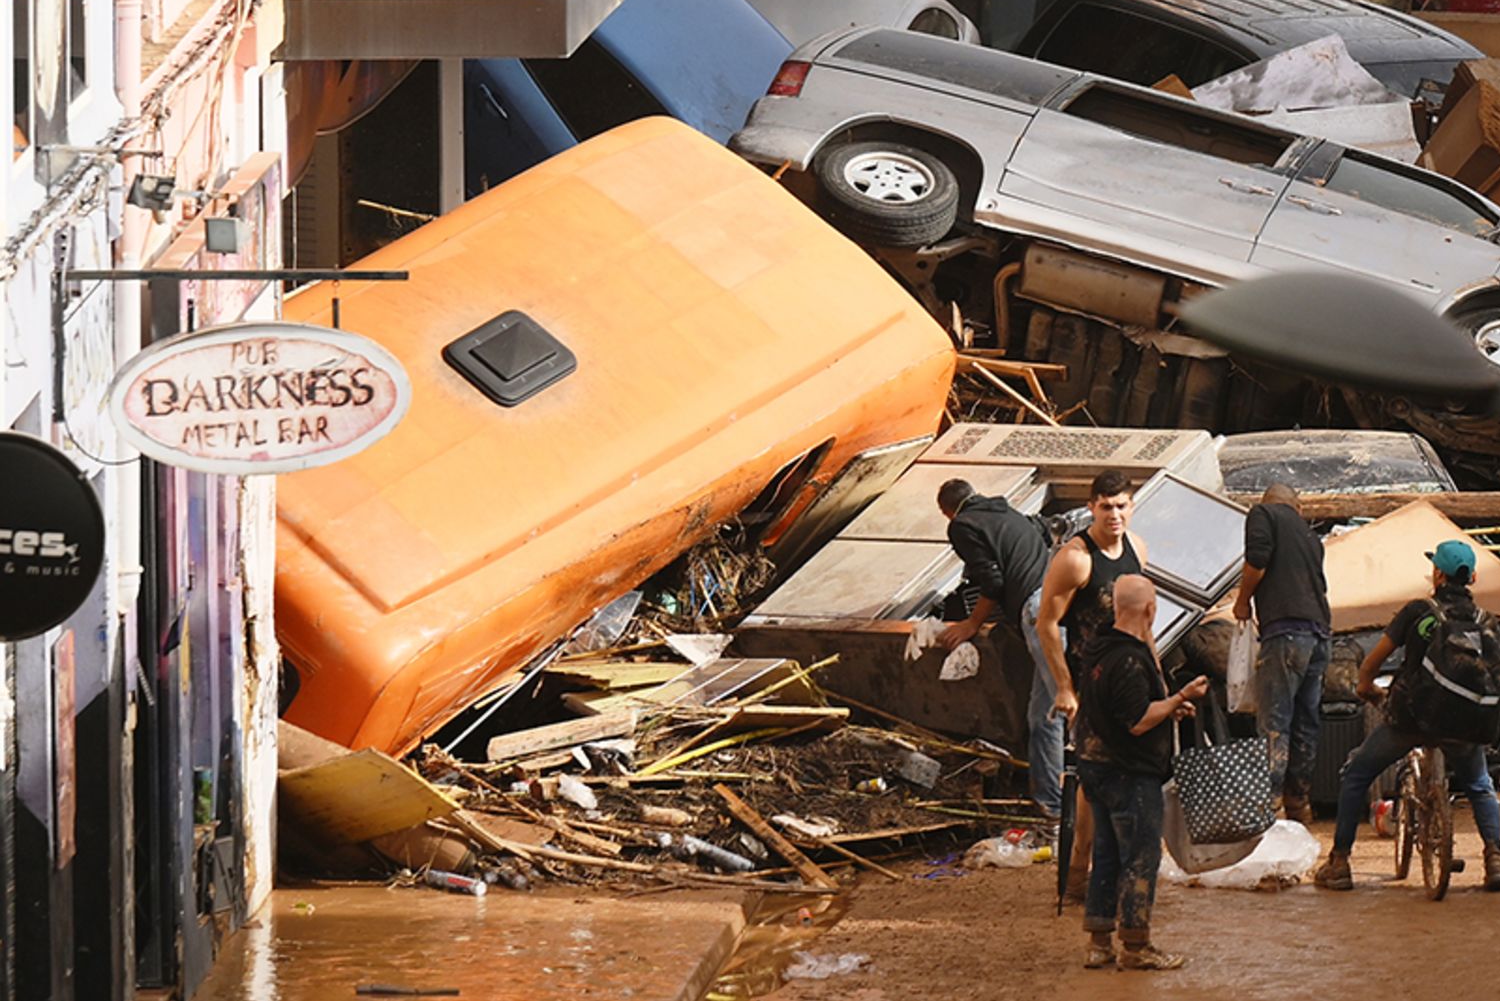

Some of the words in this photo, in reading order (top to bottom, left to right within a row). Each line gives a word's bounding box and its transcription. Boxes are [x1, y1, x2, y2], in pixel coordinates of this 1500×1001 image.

[231, 340, 278, 366] PUB
[141, 367, 375, 418] DARKNESS
[182, 418, 267, 448] METAL
[278, 415, 333, 444] BAR
[26, 565, 80, 576] music
